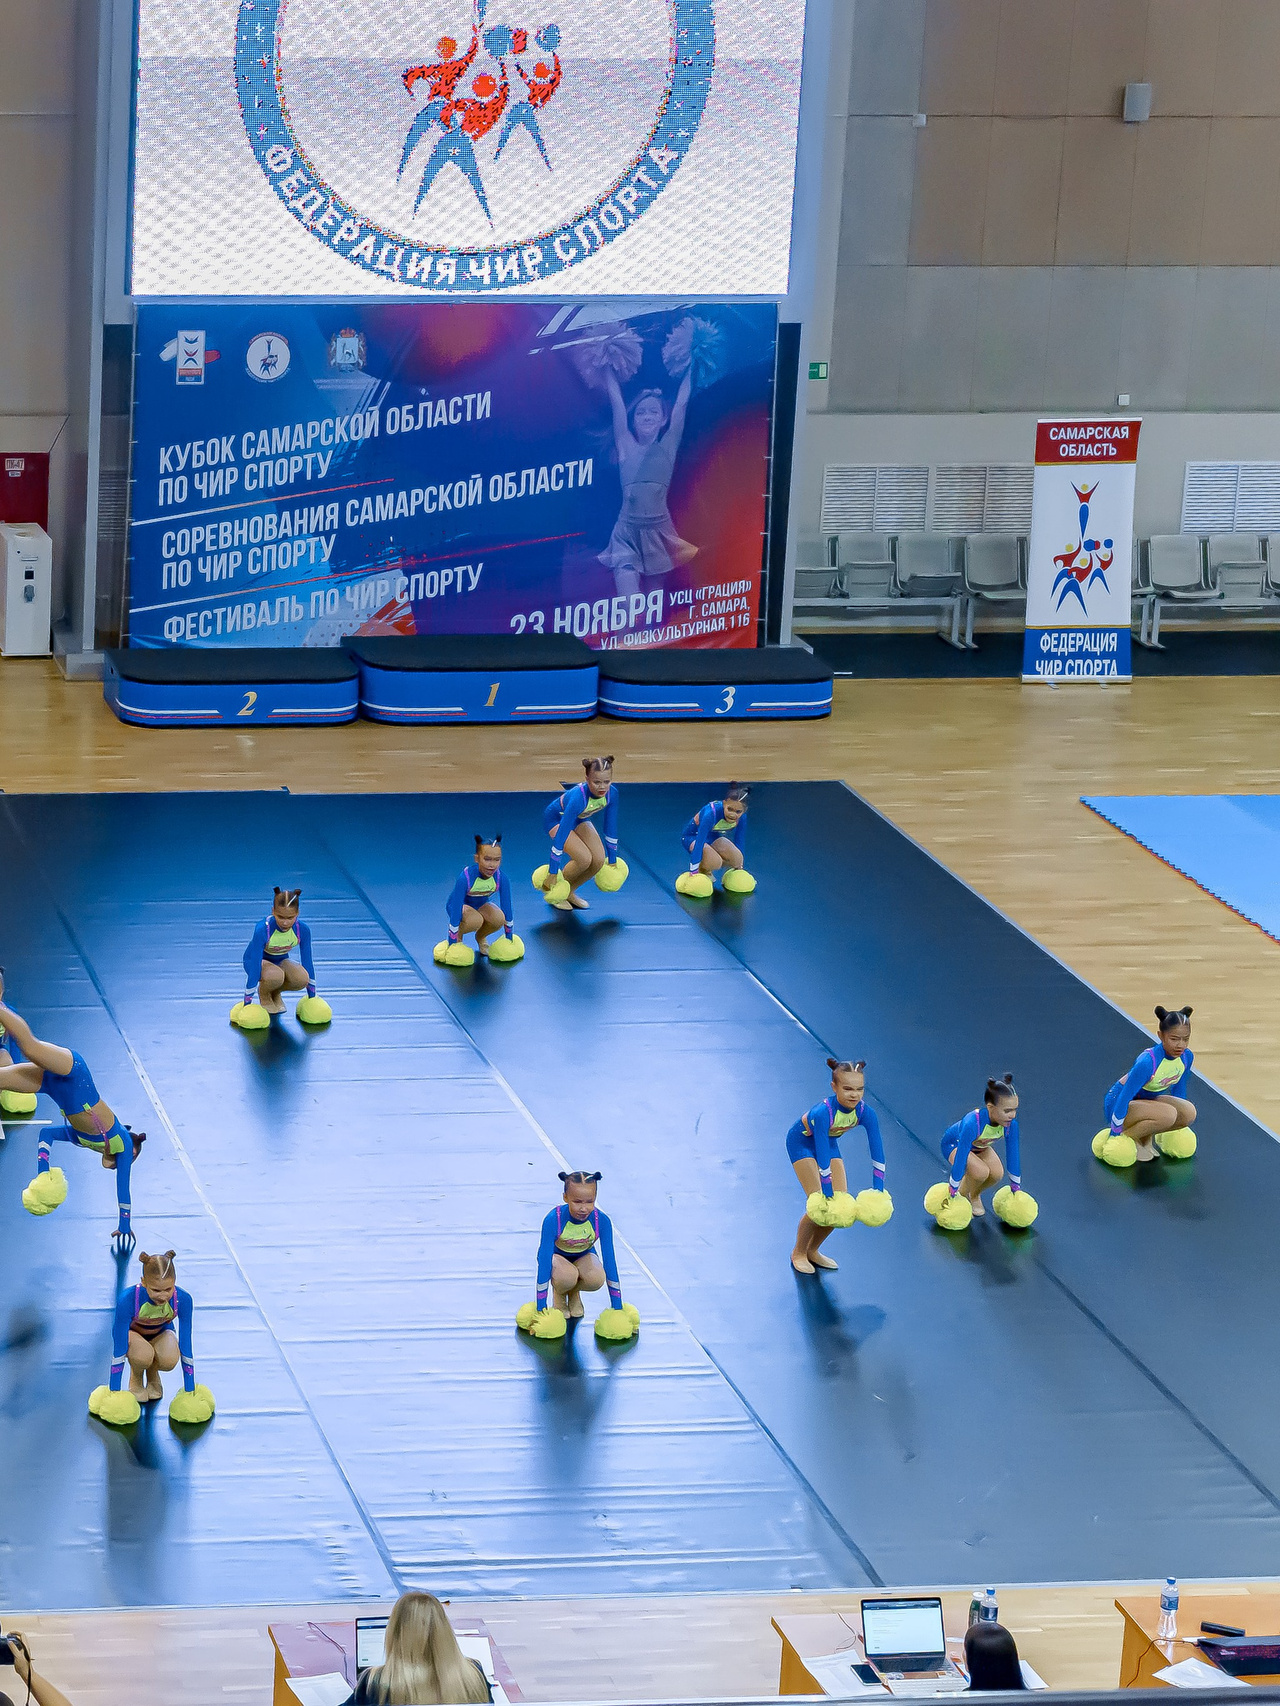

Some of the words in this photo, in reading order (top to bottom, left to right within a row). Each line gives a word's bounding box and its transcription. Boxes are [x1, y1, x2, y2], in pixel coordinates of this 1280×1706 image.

[470, 245, 543, 285] ЧИР
[553, 144, 680, 262] СПОРТА
[159, 434, 236, 474] КУБОК
[242, 405, 380, 459] САМАРСКОЙ
[386, 391, 492, 435] ОБЛАСТИ
[1049, 426, 1129, 440] САМАРСКАЯ
[1059, 443, 1117, 457] ОБЛАСТЬ
[158, 475, 188, 506] ПО
[194, 466, 239, 499] ЧИР
[244, 450, 333, 491] СПОРТУ
[162, 502, 339, 559] СОРЕВНОВАНИЯ
[345, 473, 482, 527] САМАРСКОЙ
[489, 458, 593, 501] ОБЛАСТИ
[162, 558, 192, 590] ПО
[198, 549, 242, 582] ЧИР
[247, 534, 337, 576] СПОРТУ
[163, 597, 304, 643] ФЕСТИВАЛЬ
[310, 588, 339, 620] ПО
[345, 578, 390, 611] ЧИР
[395, 563, 484, 602] СПОРТУ
[669, 589, 693, 606] УСЦ
[695, 579, 752, 601] «ГРАЦИЯ»
[510, 611, 545, 635] 23
[554, 589, 664, 638] НОЯБРЯ
[688, 605, 699, 619] Г.
[701, 597, 751, 617] САМАРА,
[1040, 632, 1118, 656] ФЕДЕРАЦИЯ
[1035, 660, 1062, 676] ЧИР
[1064, 659, 1118, 676] СПОРТА
[237, 690, 258, 716] 2
[484, 682, 501, 708] 1
[714, 686, 736, 714] 3
